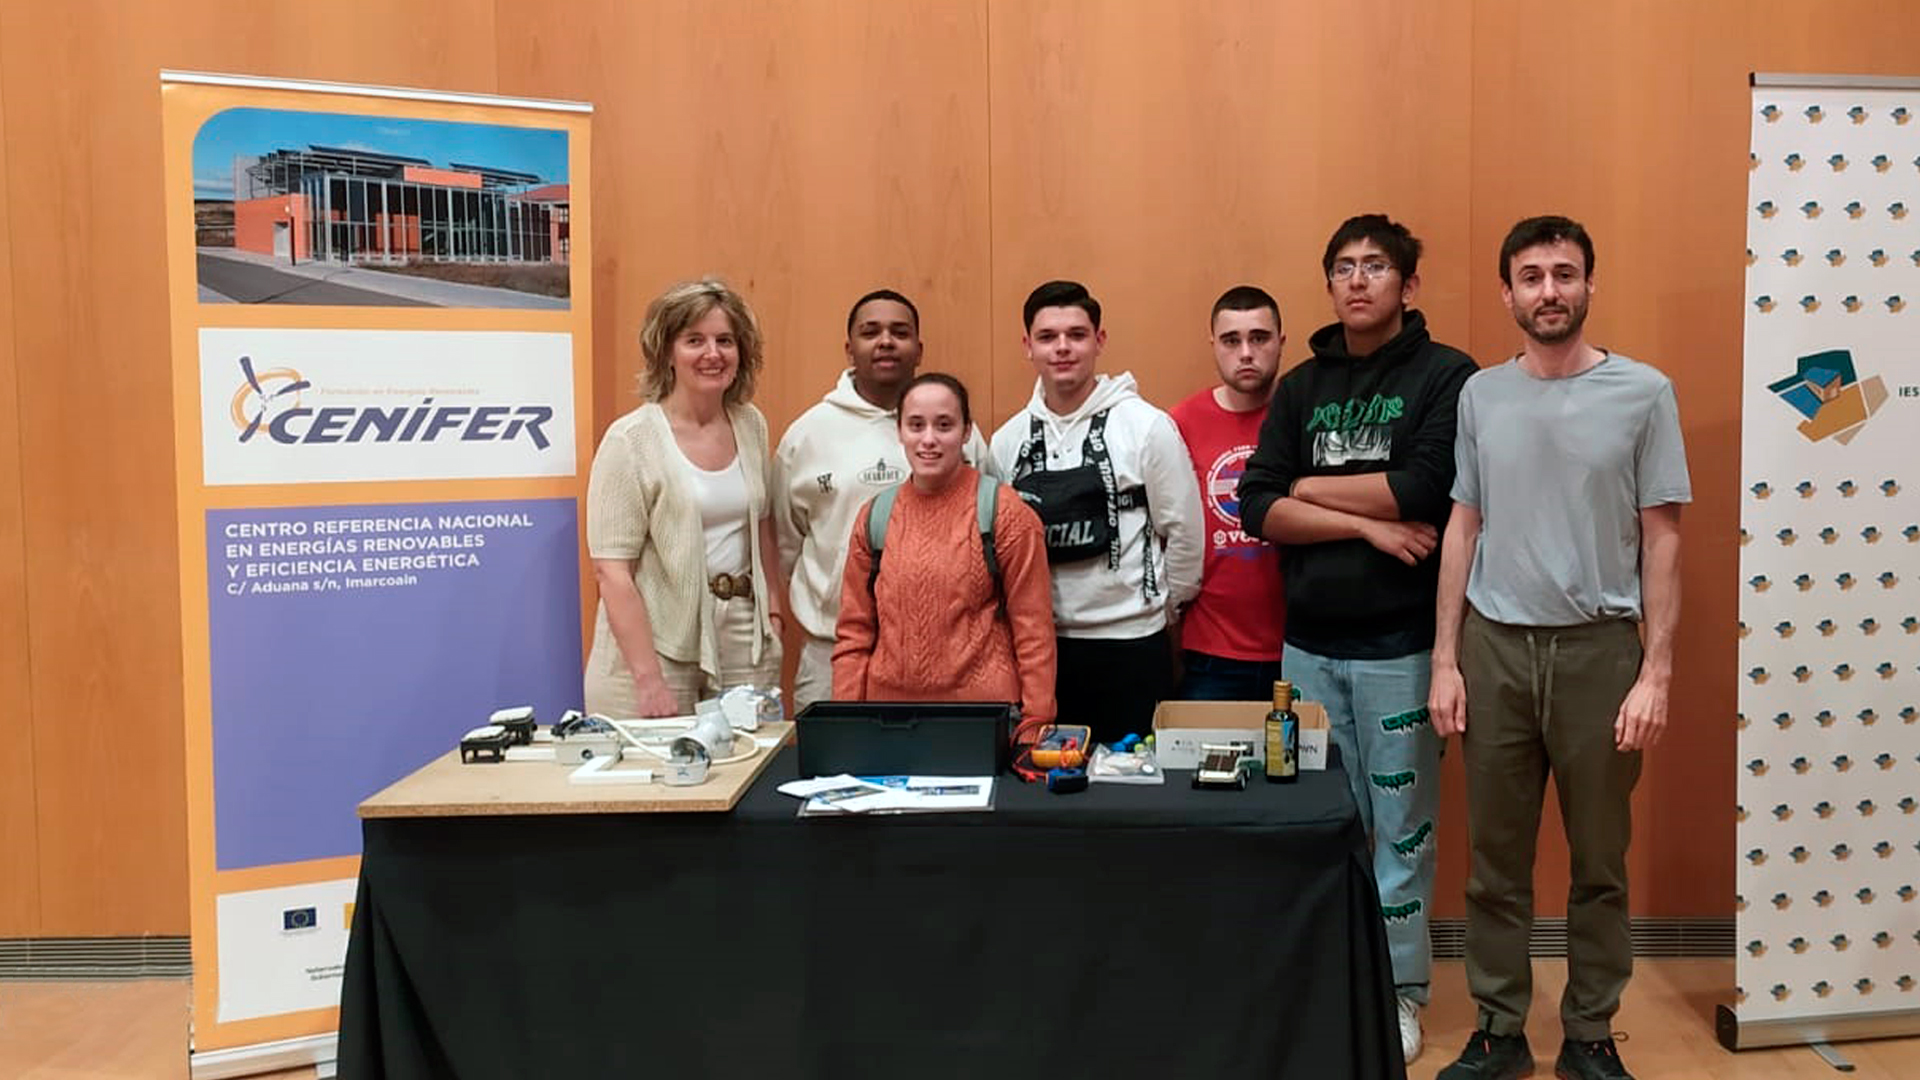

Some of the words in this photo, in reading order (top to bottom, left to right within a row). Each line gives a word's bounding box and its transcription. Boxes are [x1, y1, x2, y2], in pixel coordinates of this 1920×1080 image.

[1898, 386, 1919, 398] IES
[225, 522, 307, 538] CENTRO
[313, 517, 433, 535] REFERENCIA
[438, 513, 534, 530] NACIONAL
[1045, 520, 1095, 548] CIAL
[226, 543, 253, 558] EN
[259, 537, 358, 557] ENERGÍAS
[363, 534, 486, 552] RENOVABLES
[226, 564, 240, 579] Y
[246, 559, 357, 578] EFICIENCIA
[362, 552, 480, 572] ENERGÉTICA
[226, 581, 247, 596] C/
[251, 580, 309, 594] Aduana
[313, 577, 342, 591] s/n,
